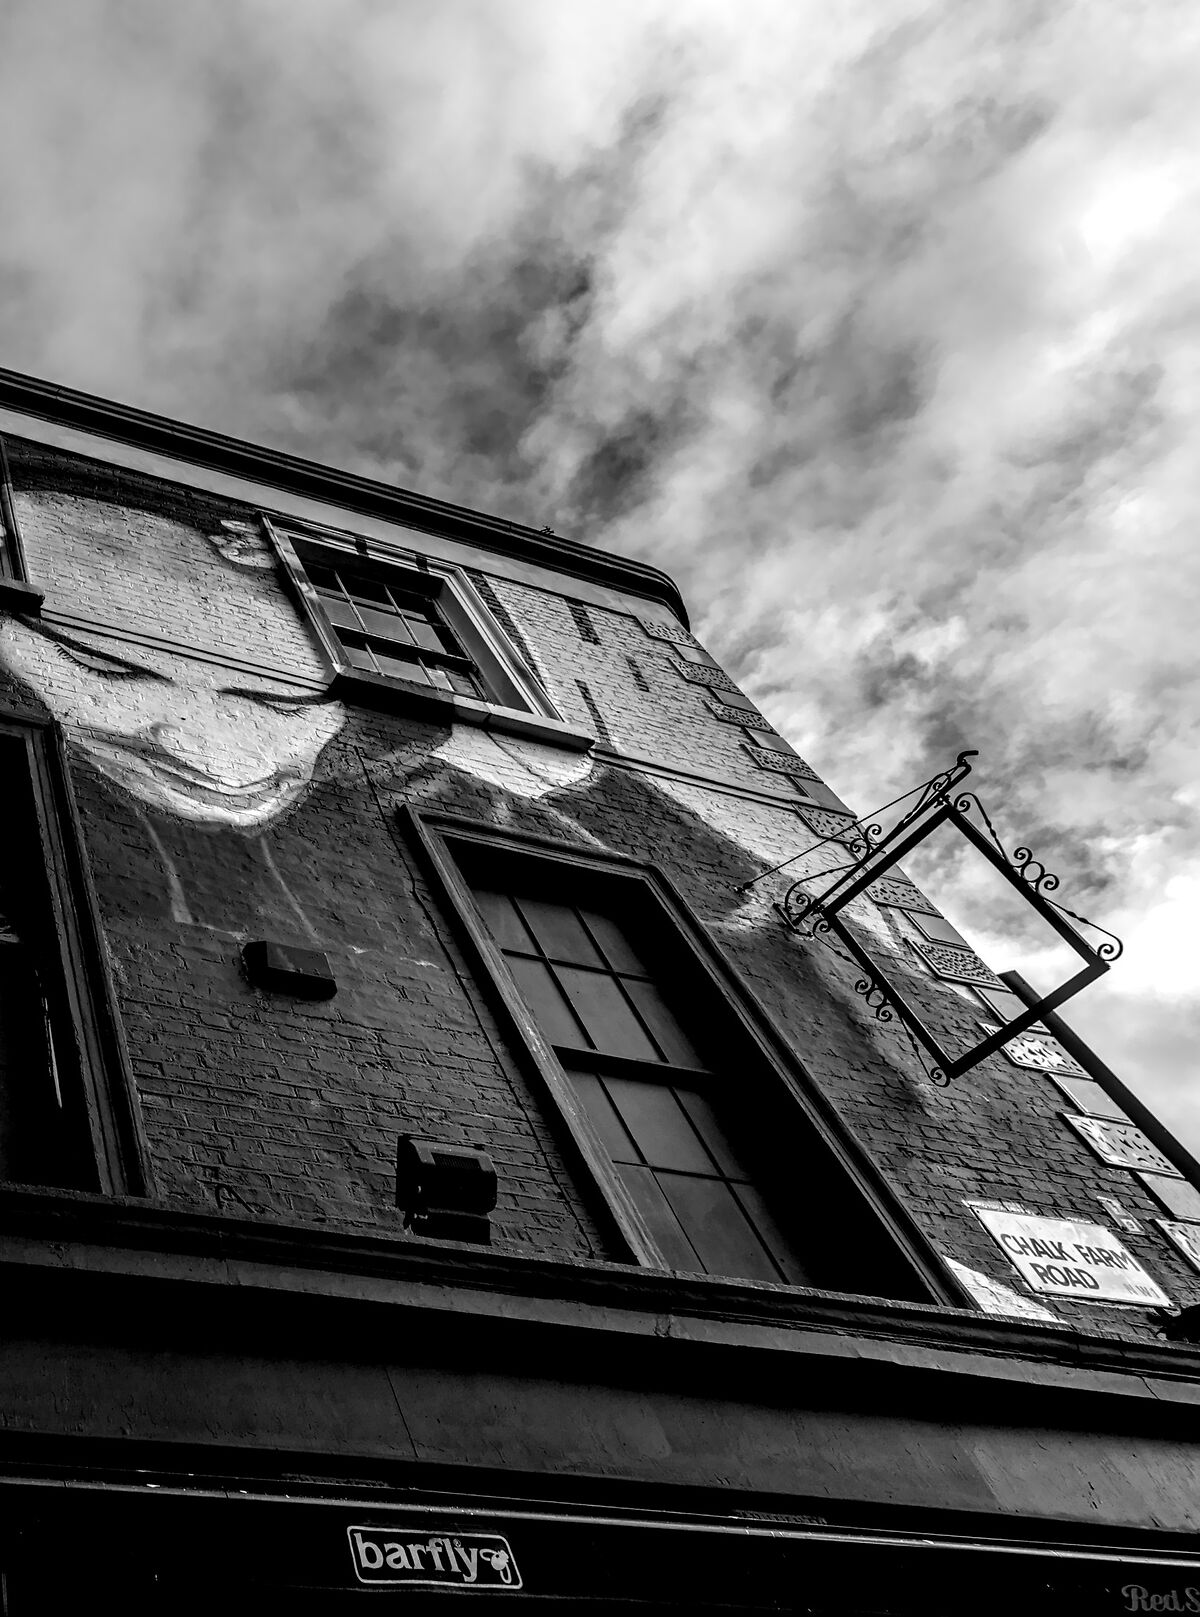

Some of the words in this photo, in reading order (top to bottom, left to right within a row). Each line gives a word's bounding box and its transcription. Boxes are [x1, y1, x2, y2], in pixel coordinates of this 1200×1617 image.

[1000, 1233, 1077, 1263] CHALK
[1073, 1243, 1141, 1272] FARM
[1029, 1262, 1100, 1290] ROAD
[353, 1532, 479, 1583] barfly
[1120, 1583, 1186, 1612] Red
